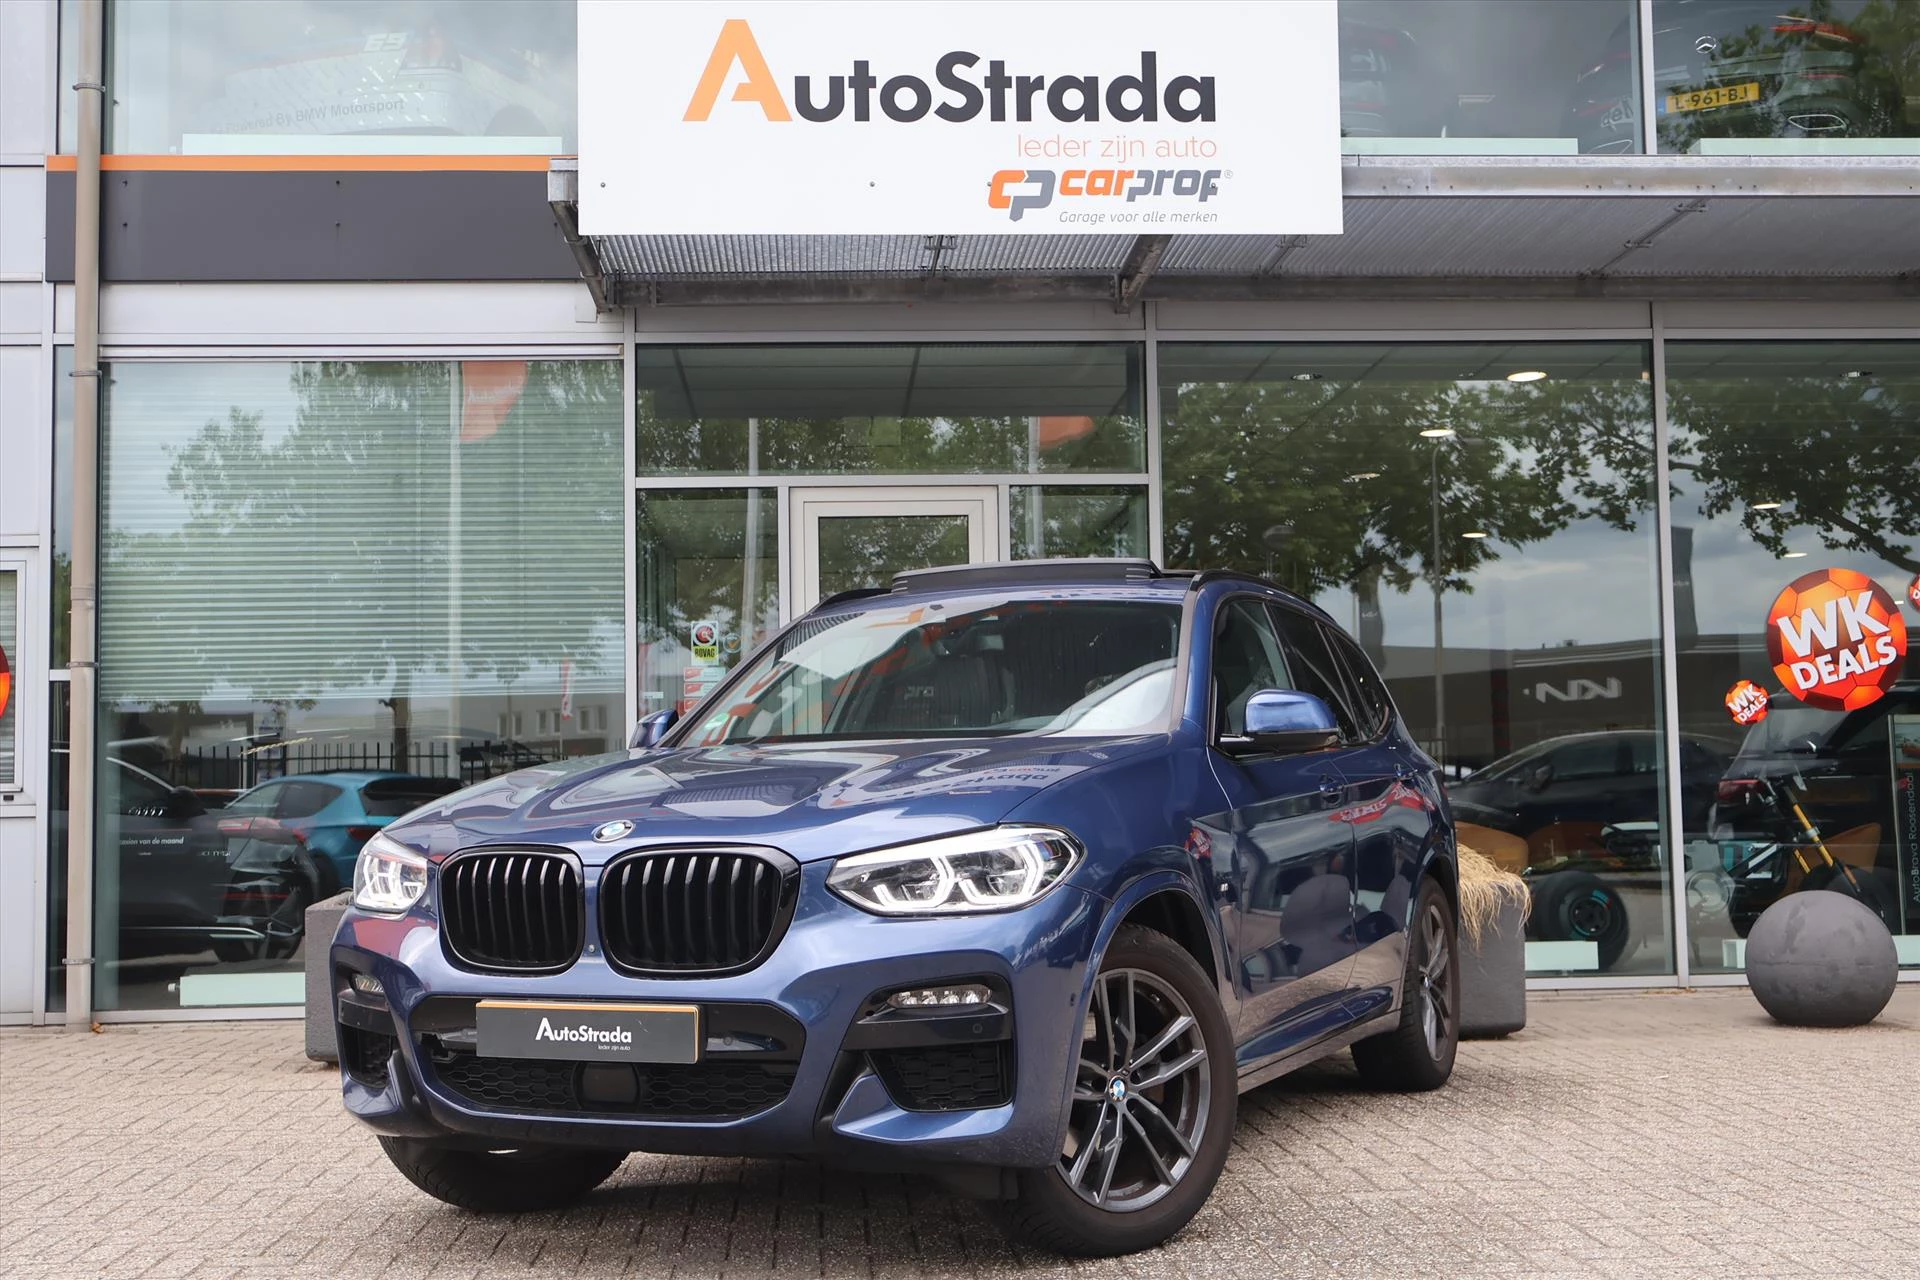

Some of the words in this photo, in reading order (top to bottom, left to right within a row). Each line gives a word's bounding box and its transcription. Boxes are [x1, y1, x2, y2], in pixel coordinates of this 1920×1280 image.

[682, 18, 1216, 123] AutoStrada
[276, 111, 291, 127] By
[295, 106, 327, 122] BMW
[330, 99, 405, 118] Motorsport
[1017, 134, 1092, 158] Ieder
[1100, 135, 1145, 163] zijn
[1155, 136, 1217, 158] auto
[1059, 170, 1222, 202] carprof
[1059, 211, 1105, 226] Garage
[1110, 213, 1138, 223] voor
[1142, 211, 1167, 223] alle
[1170, 211, 1218, 223] merken
[1776, 591, 1891, 657] WK
[1790, 636, 1897, 690] DEALS
[1727, 684, 1762, 713] WK
[1737, 694, 1767, 722] DEALS
[152, 836, 160, 845] de
[161, 836, 185, 845] maand
[535, 1017, 632, 1043] AutoStrada
